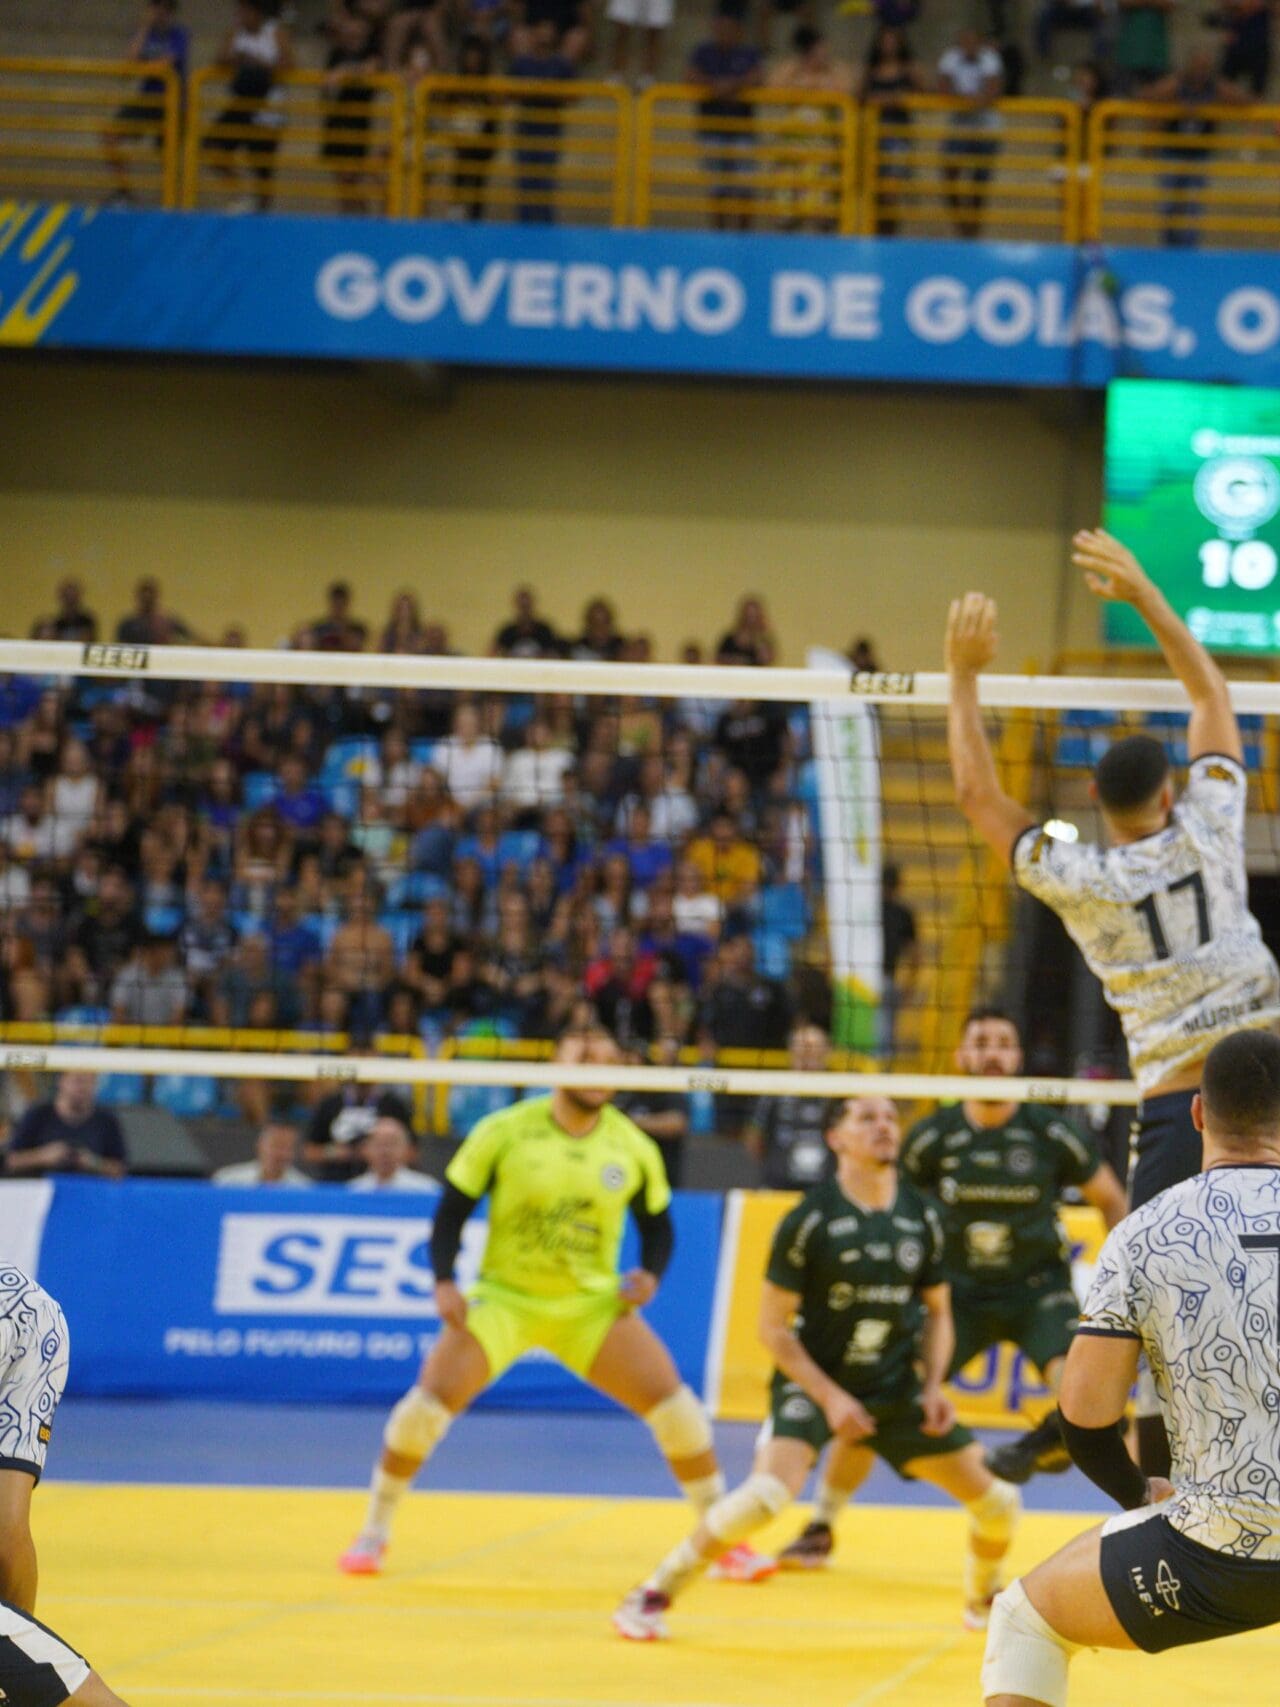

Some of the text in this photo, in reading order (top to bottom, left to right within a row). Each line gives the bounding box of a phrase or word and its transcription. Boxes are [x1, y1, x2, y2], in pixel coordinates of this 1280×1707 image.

[316, 252, 745, 335] GOVERNO
[770, 271, 882, 340] DE
[1199, 538, 1278, 590] 10
[1136, 872, 1214, 960] 17
[252, 1232, 440, 1297] SES
[164, 1327, 242, 1356] PELO
[245, 1328, 363, 1359] FUTURO
[366, 1331, 413, 1361] DO
